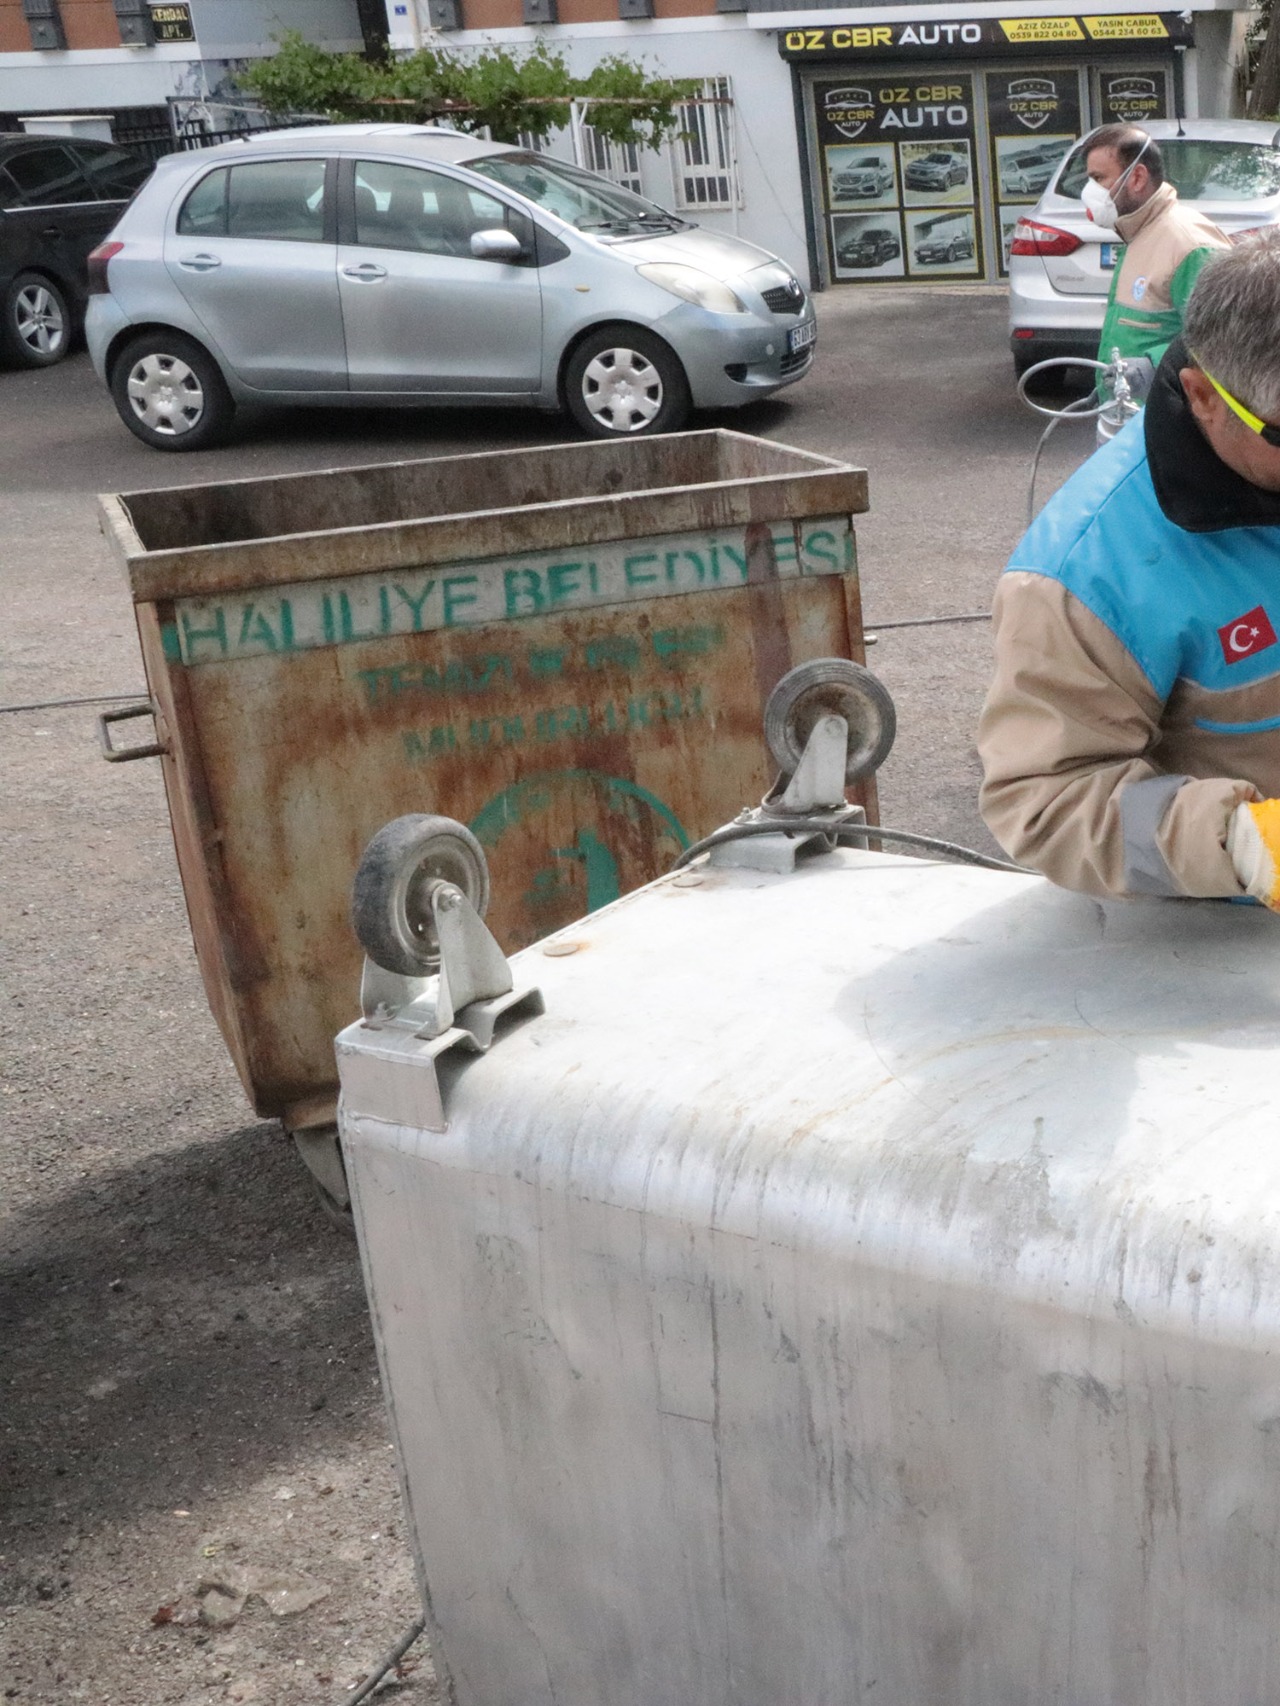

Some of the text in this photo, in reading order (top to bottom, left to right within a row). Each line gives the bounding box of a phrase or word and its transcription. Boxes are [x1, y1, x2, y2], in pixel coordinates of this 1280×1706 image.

[832, 27, 893, 48] CBR
[898, 24, 982, 46] AUTO
[916, 85, 963, 101] CBR
[1030, 100, 1059, 111] CBR
[1130, 100, 1159, 110] CBR
[847, 110, 875, 120] CBR
[879, 105, 968, 130] AUTO
[841, 120, 861, 128] AUTO
